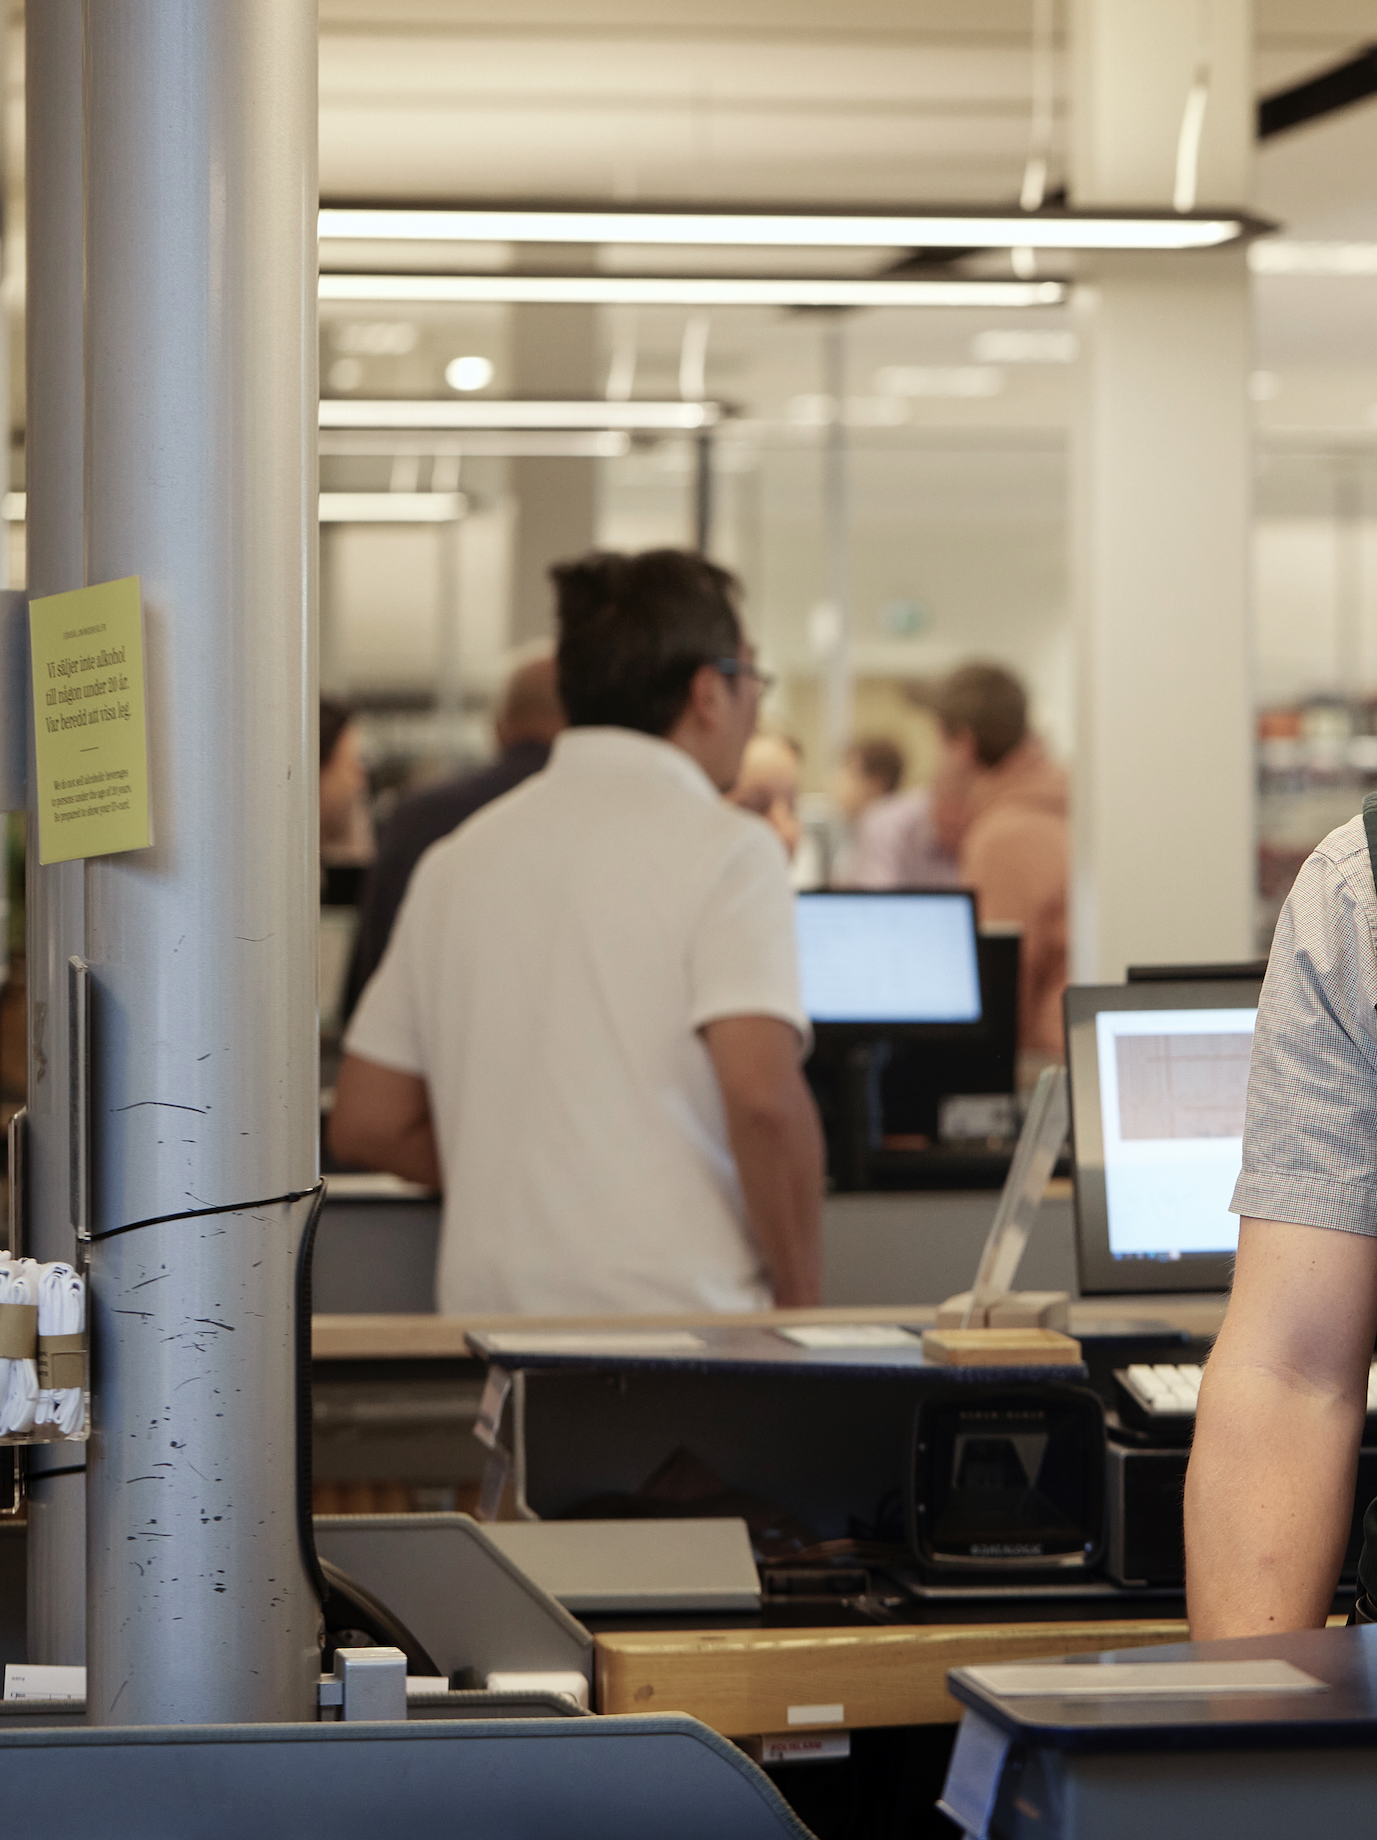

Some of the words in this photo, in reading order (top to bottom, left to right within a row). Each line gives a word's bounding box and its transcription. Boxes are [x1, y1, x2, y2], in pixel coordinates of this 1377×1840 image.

[46, 661, 56, 678] Vi
[57, 658, 78, 678] säljer
[79, 655, 95, 672] inte
[96, 645, 126, 668] alkohol
[45, 687, 57, 706] till
[58, 684, 82, 705] någon
[83, 679, 106, 698] under
[107, 676, 118, 693] 20
[45, 716, 59, 733] Var
[60, 708, 87, 730] beredd
[88, 707, 99, 724] att
[100, 704, 116, 721] visa
[117, 701, 132, 721] leg.
